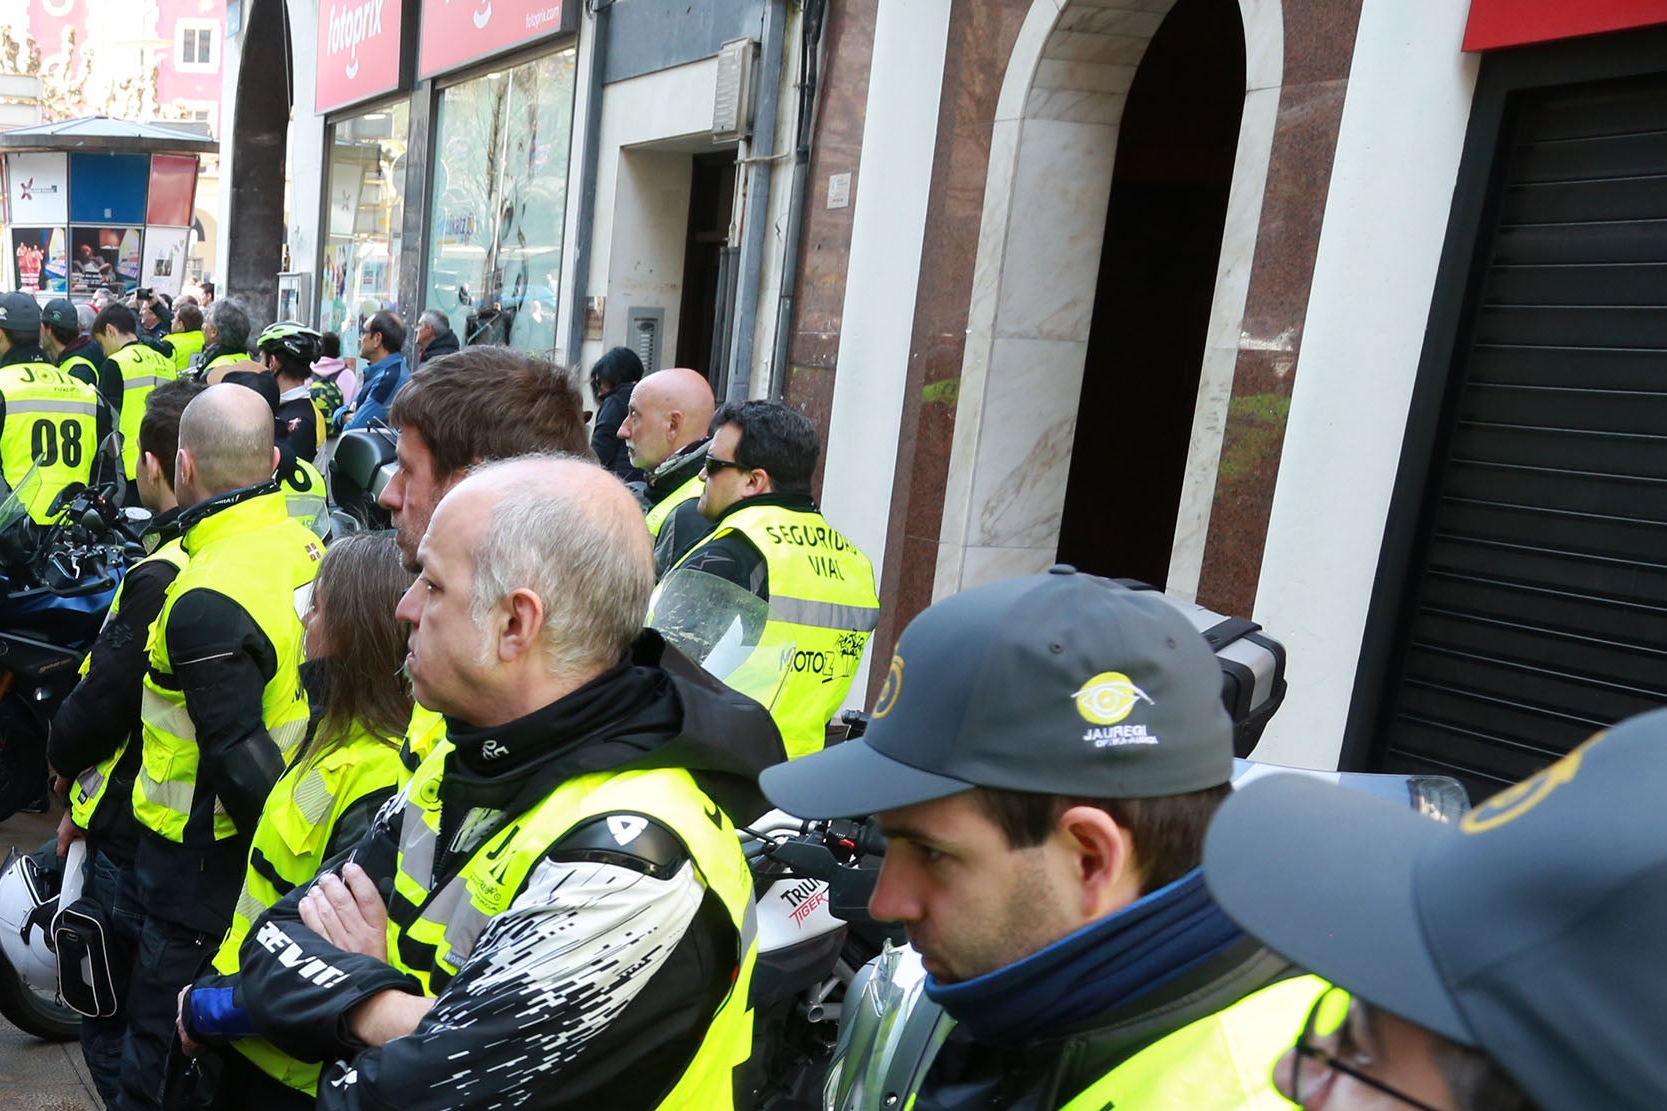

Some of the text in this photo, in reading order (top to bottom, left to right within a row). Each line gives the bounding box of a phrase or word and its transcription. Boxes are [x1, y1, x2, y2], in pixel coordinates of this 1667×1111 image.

[327, 2, 384, 58] fotoprix
[31, 418, 83, 468] 08
[807, 555, 845, 582] VIAL
[1083, 725, 1148, 741] JAUREGI
[788, 892, 830, 929] TIGER
